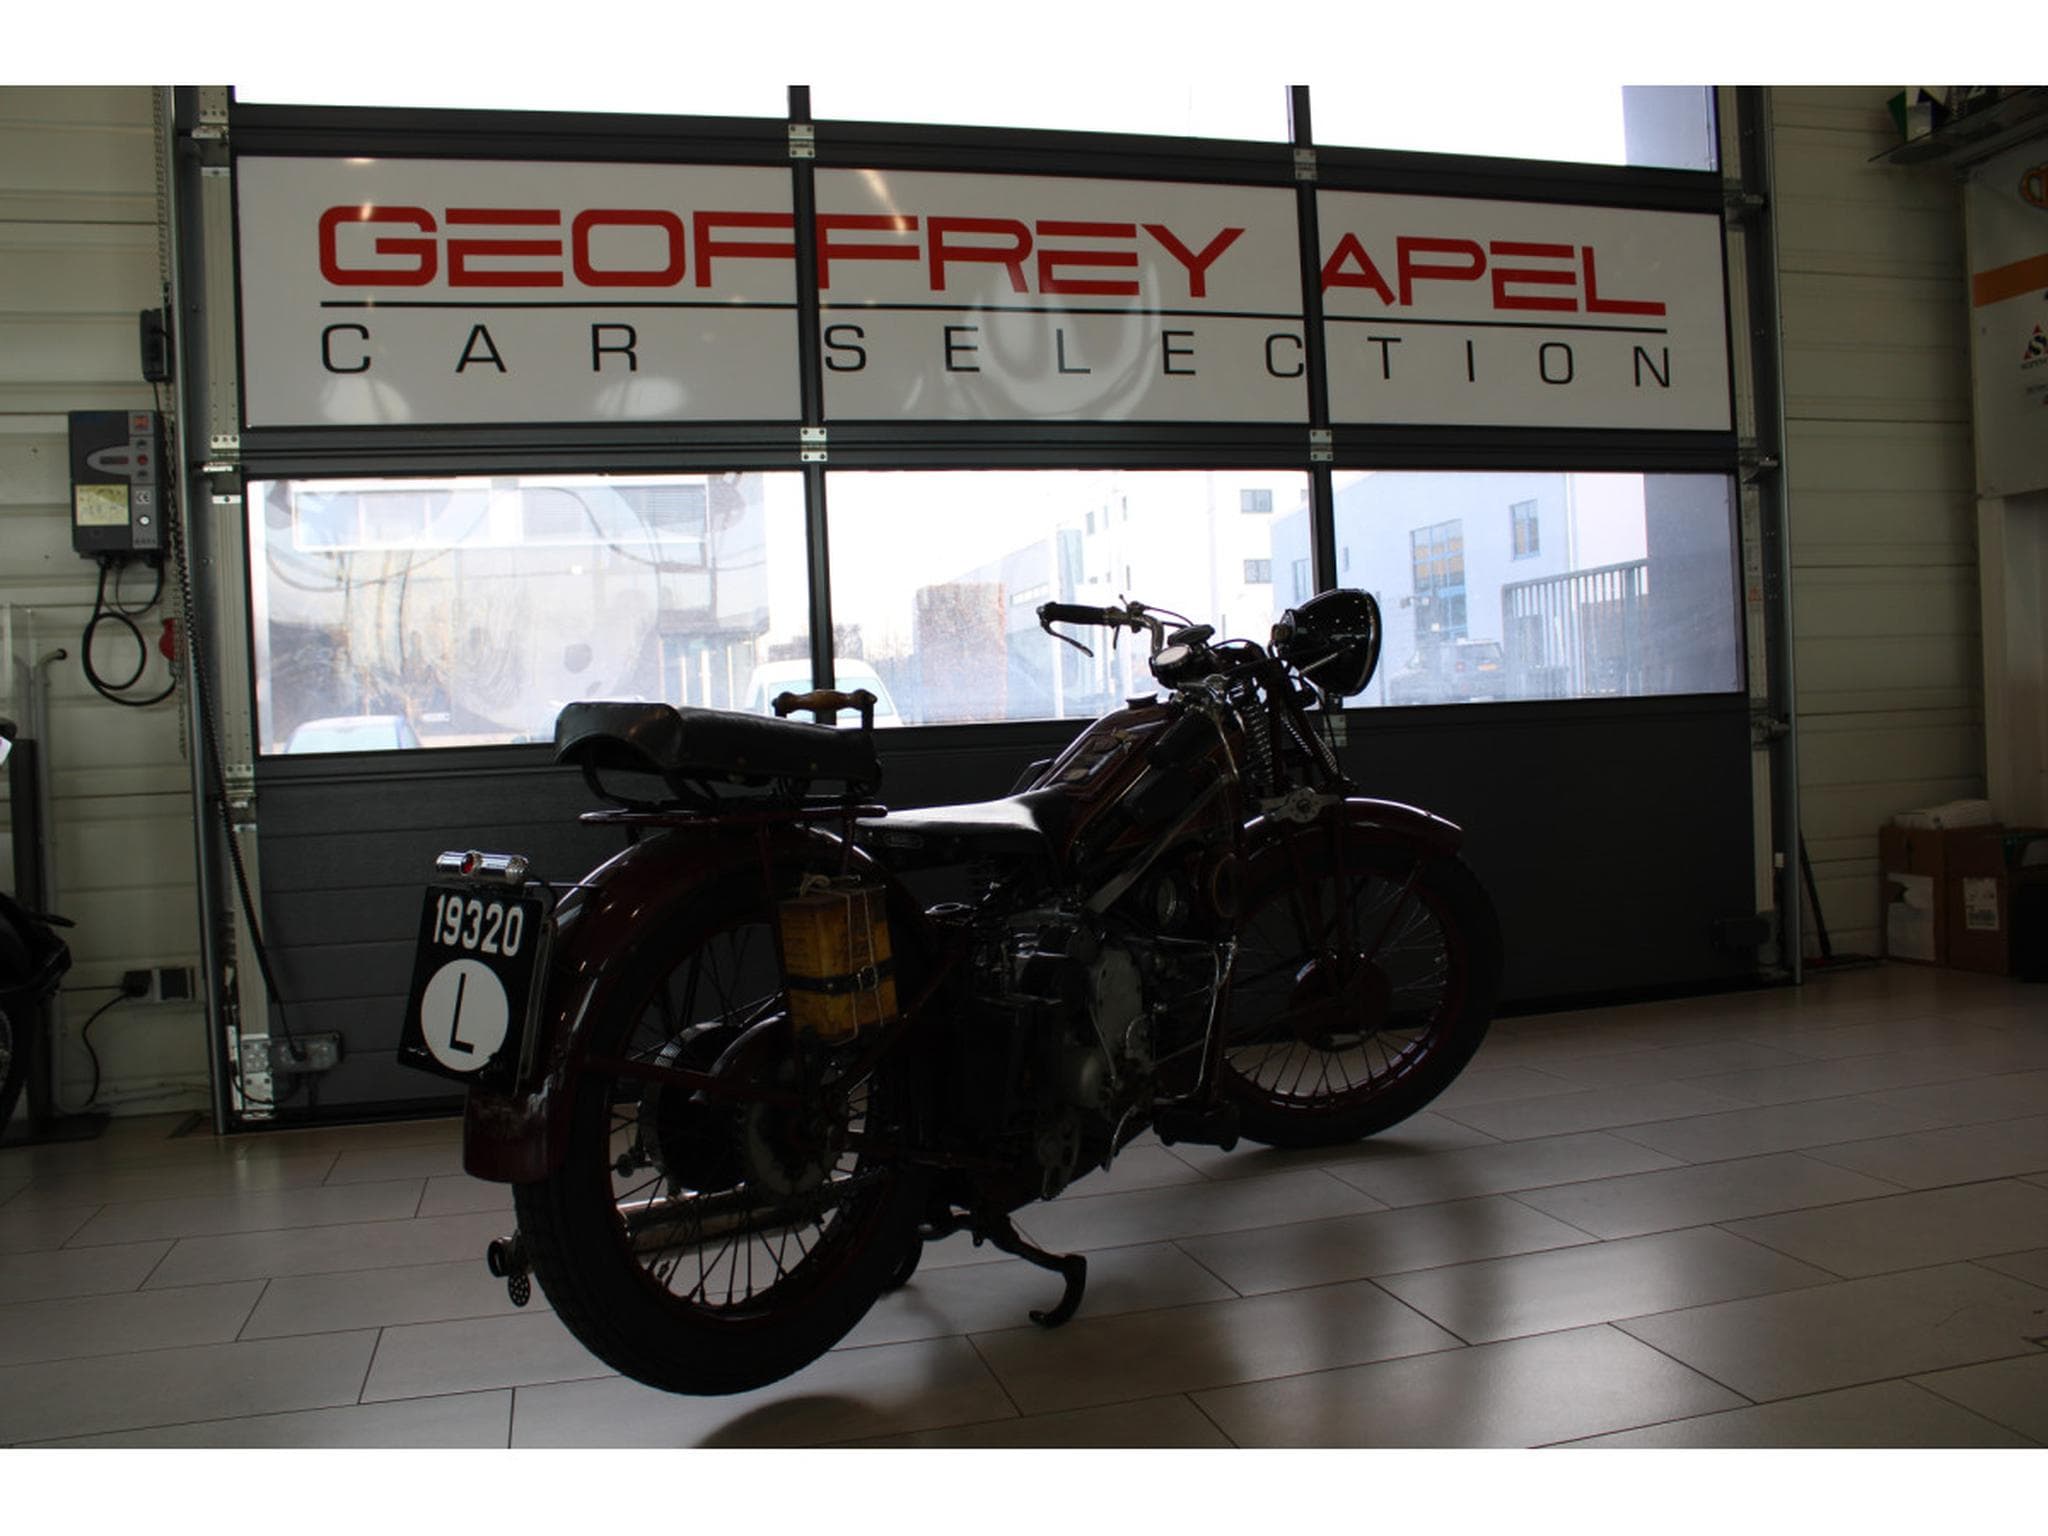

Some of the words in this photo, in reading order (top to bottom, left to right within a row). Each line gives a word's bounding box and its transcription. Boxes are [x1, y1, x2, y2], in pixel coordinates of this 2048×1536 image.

[319, 206, 1245, 297] GEOFFREY
[1321, 233, 1666, 316] APEL
[321, 323, 637, 373] CAR
[825, 325, 1670, 388] SELECTION
[432, 893, 525, 958] 19320
[450, 972, 474, 1054] L
